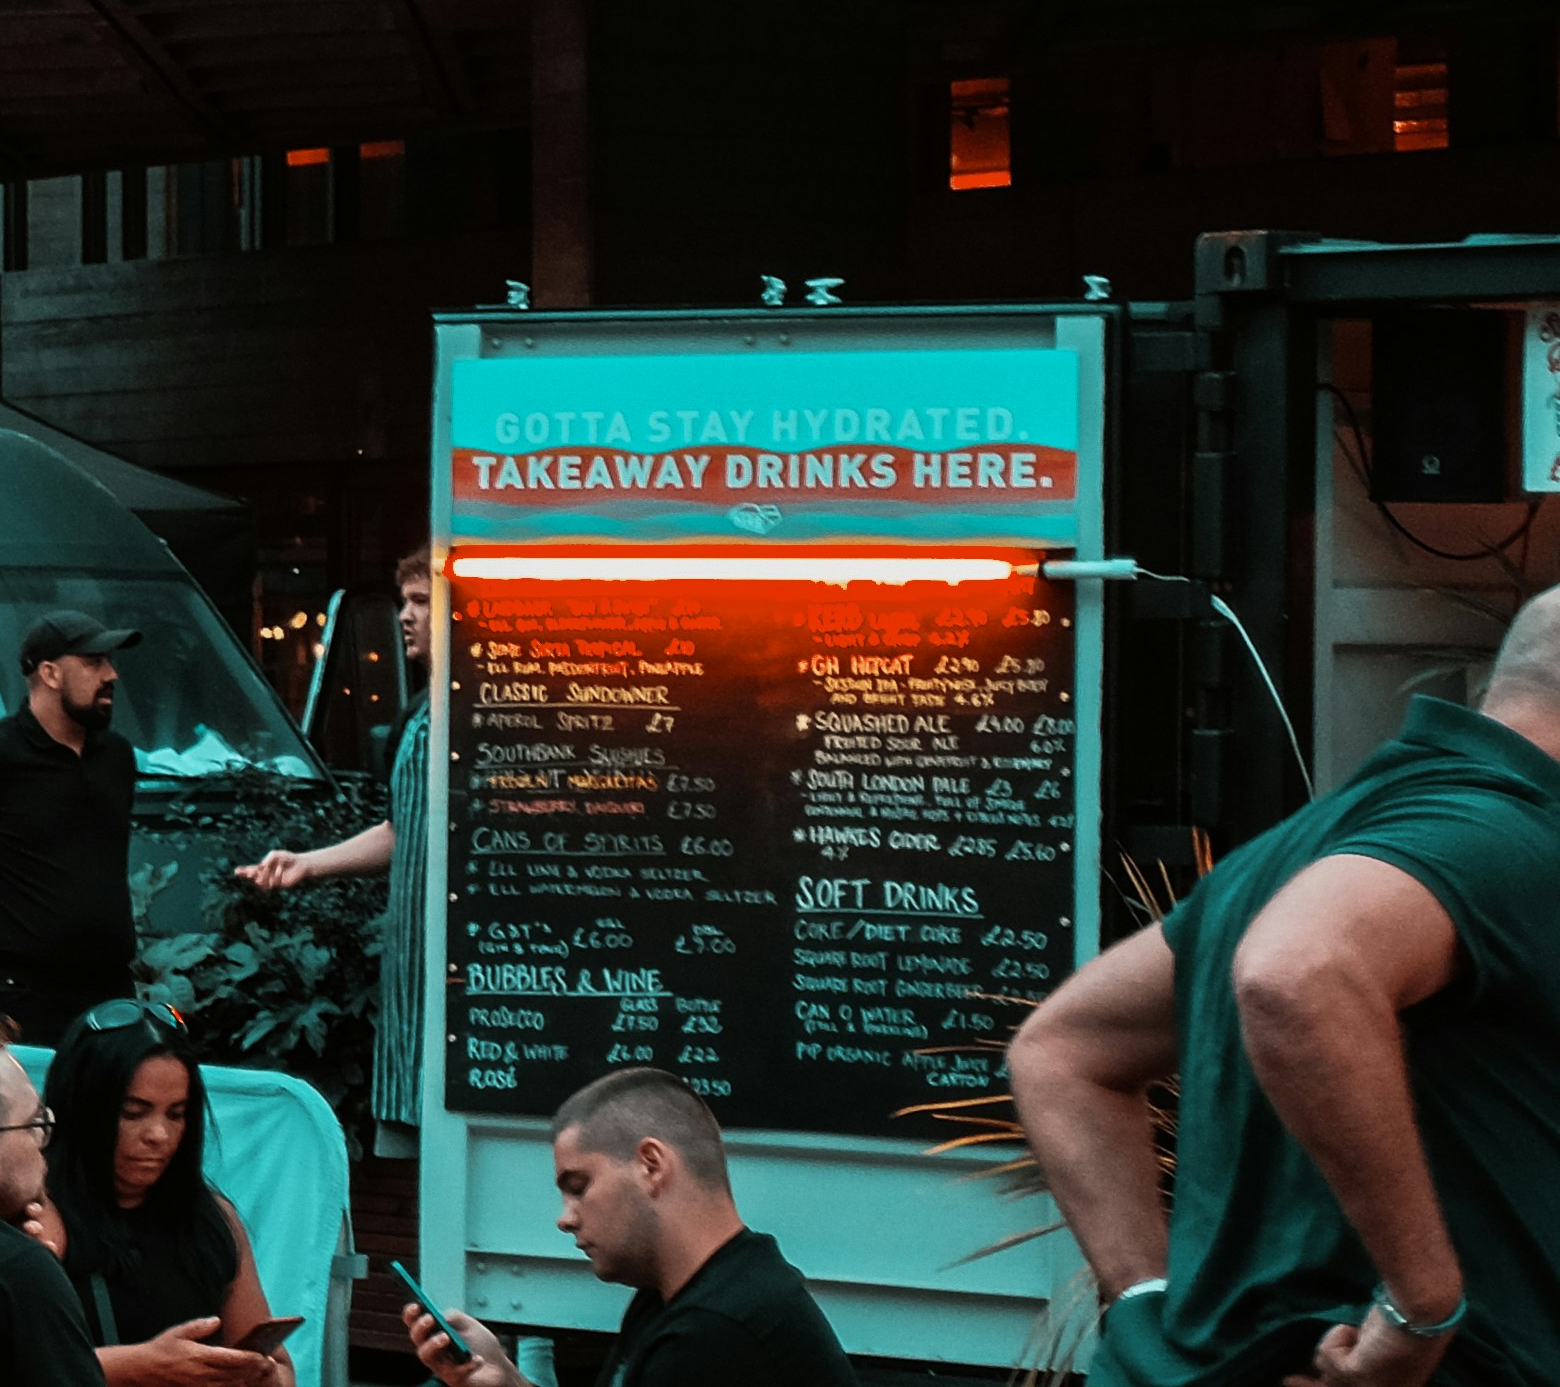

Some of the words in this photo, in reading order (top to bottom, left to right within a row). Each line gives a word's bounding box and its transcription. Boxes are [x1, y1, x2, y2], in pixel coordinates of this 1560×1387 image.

[495, 411, 632, 444] GOTTA
[648, 410, 754, 443] STAY
[772, 407, 1029, 442] HYDRATED.
[472, 454, 711, 489] TAKEAWAY
[725, 452, 898, 489] DRINKS
[913, 452, 1054, 488] HERE.
[479, 682, 550, 704] CLASSIC
[813, 710, 909, 735] SQUASHED
[913, 713, 952, 735] ALE
[476, 742, 577, 766] SOUTHBANK
[806, 768, 855, 791] SOUTH
[861, 772, 926, 793] LONDON
[931, 775, 971, 795] PALE
[470, 827, 532, 852] CANS
[542, 831, 568, 851] OF
[584, 831, 665, 854] SPIRITS
[807, 824, 882, 849] HAWKES
[888, 829, 942, 852] CIDER
[795, 875, 872, 911] SOFT
[882, 879, 980, 915] DRINKS
[920, 923, 963, 945] COKE
[980, 924, 1049, 951] £2.50
[792, 947, 847, 968] SQUARE
[850, 950, 889, 971] ROOT
[896, 952, 972, 977] LEMONADE
[467, 962, 569, 995] BUBBLES
[576, 967, 598, 994] &
[601, 967, 664, 994] WINE
[851, 977, 889, 998] ROOT
[469, 1005, 545, 1031] PROSECCO
[794, 999, 831, 1022] CAN
[859, 1006, 919, 1027] WATER
[466, 1036, 502, 1062] RED
[521, 1043, 570, 1062] WHITE
[925, 1072, 991, 1089] CARTON
